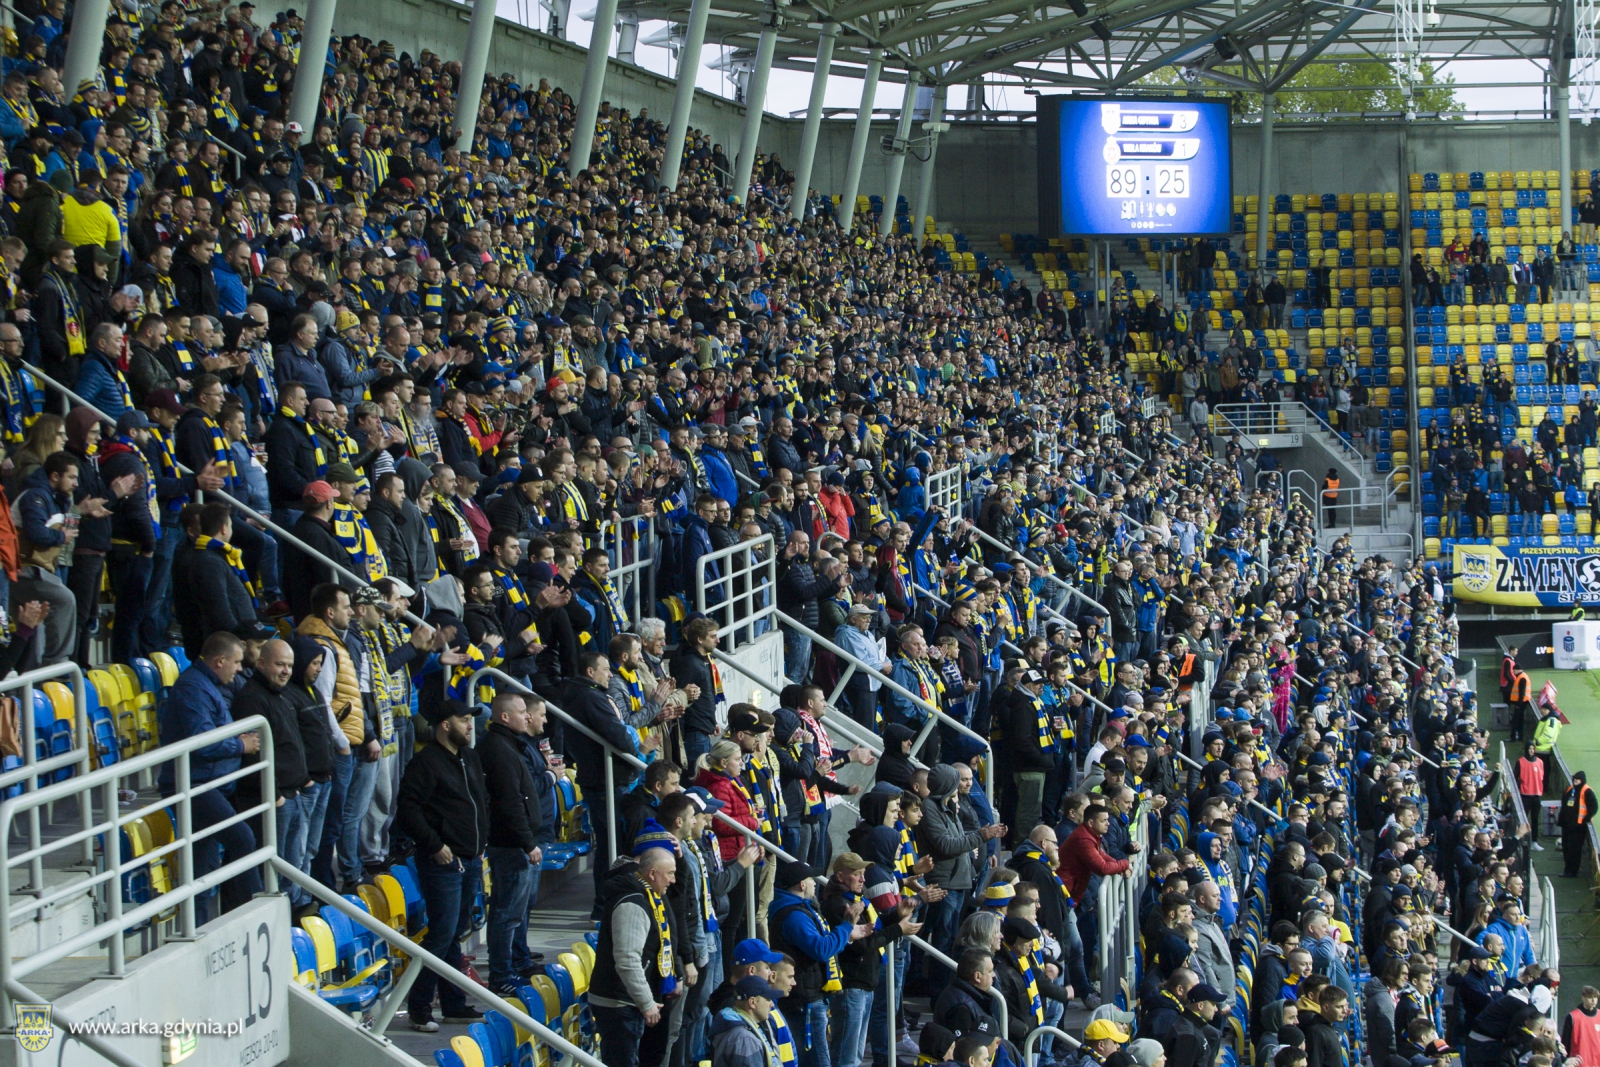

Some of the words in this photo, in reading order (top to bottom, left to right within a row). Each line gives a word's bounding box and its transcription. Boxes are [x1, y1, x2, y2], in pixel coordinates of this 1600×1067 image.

[1180, 114, 1187, 129] 3
[1181, 142, 1186, 157] 1
[1110, 169, 1136, 194] 89
[1159, 169, 1185, 194] 25
[1290, 434, 1299, 444] 19
[242, 921, 272, 1028] 13
